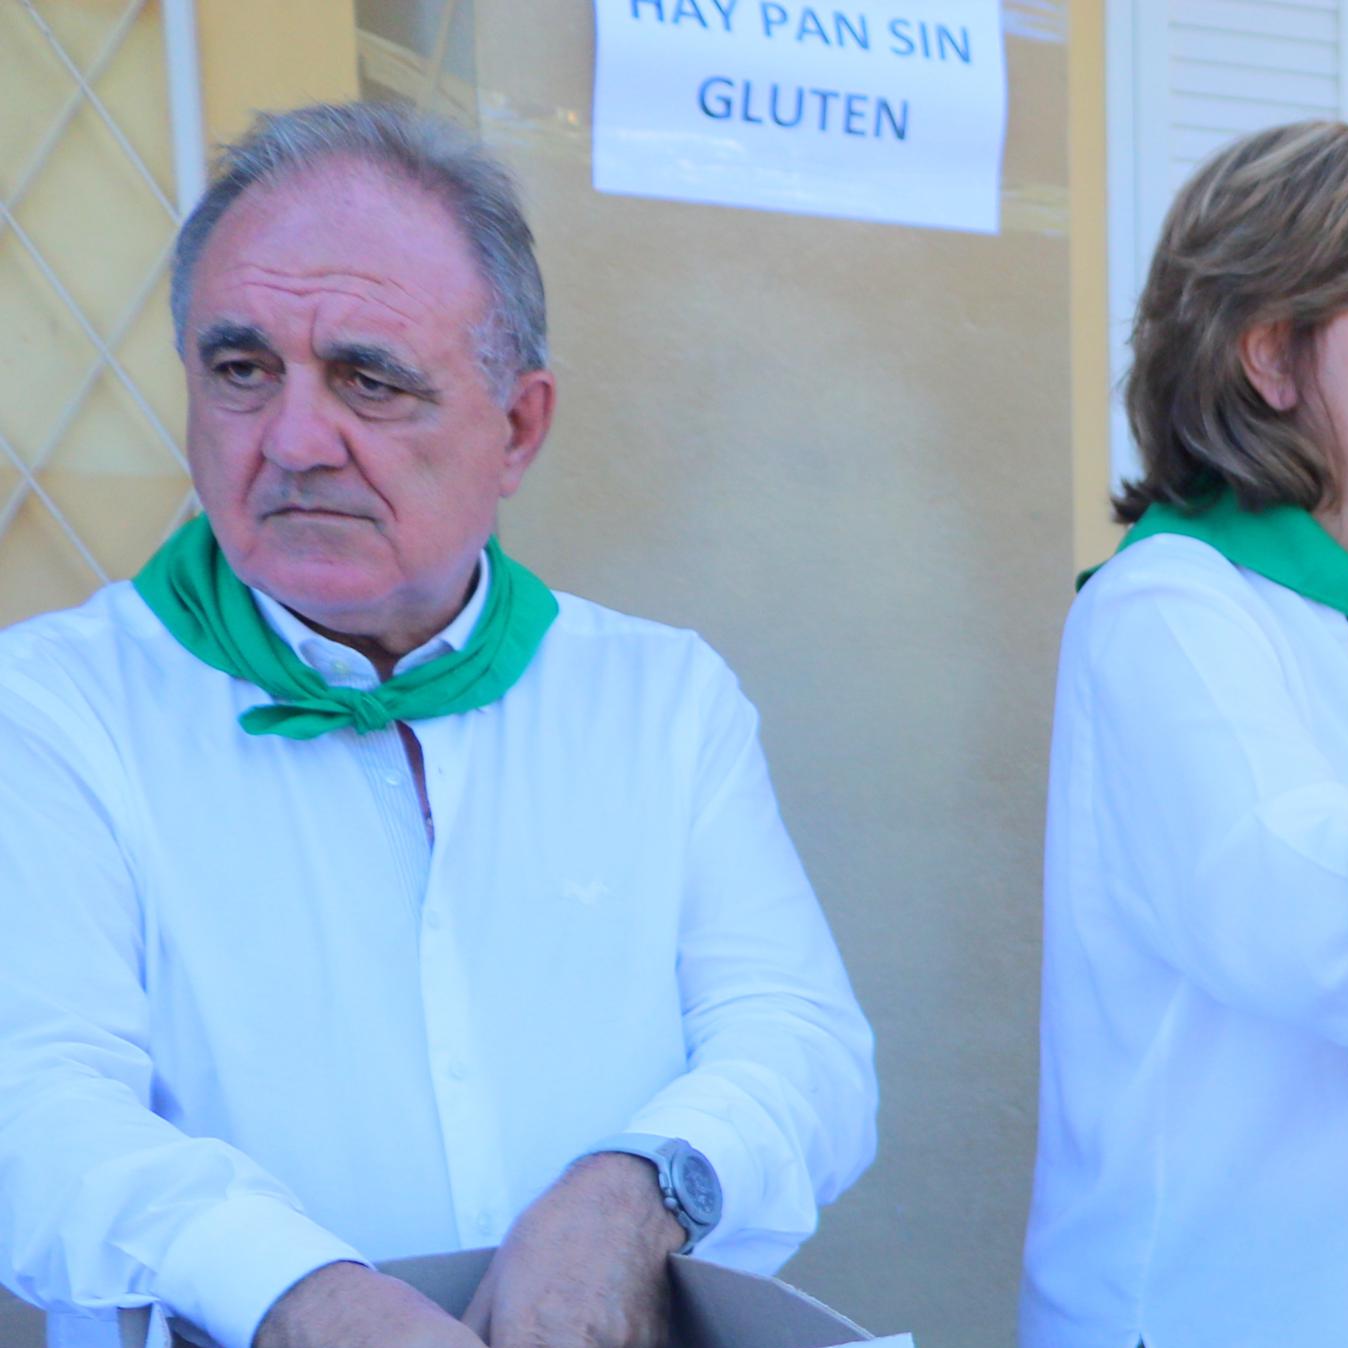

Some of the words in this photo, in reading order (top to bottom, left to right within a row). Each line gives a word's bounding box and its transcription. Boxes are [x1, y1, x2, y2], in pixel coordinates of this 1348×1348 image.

[630, 0, 736, 33] HAY
[760, 1, 871, 51] PAN
[888, 18, 972, 64] SIN
[697, 75, 909, 142] GLUTEN
